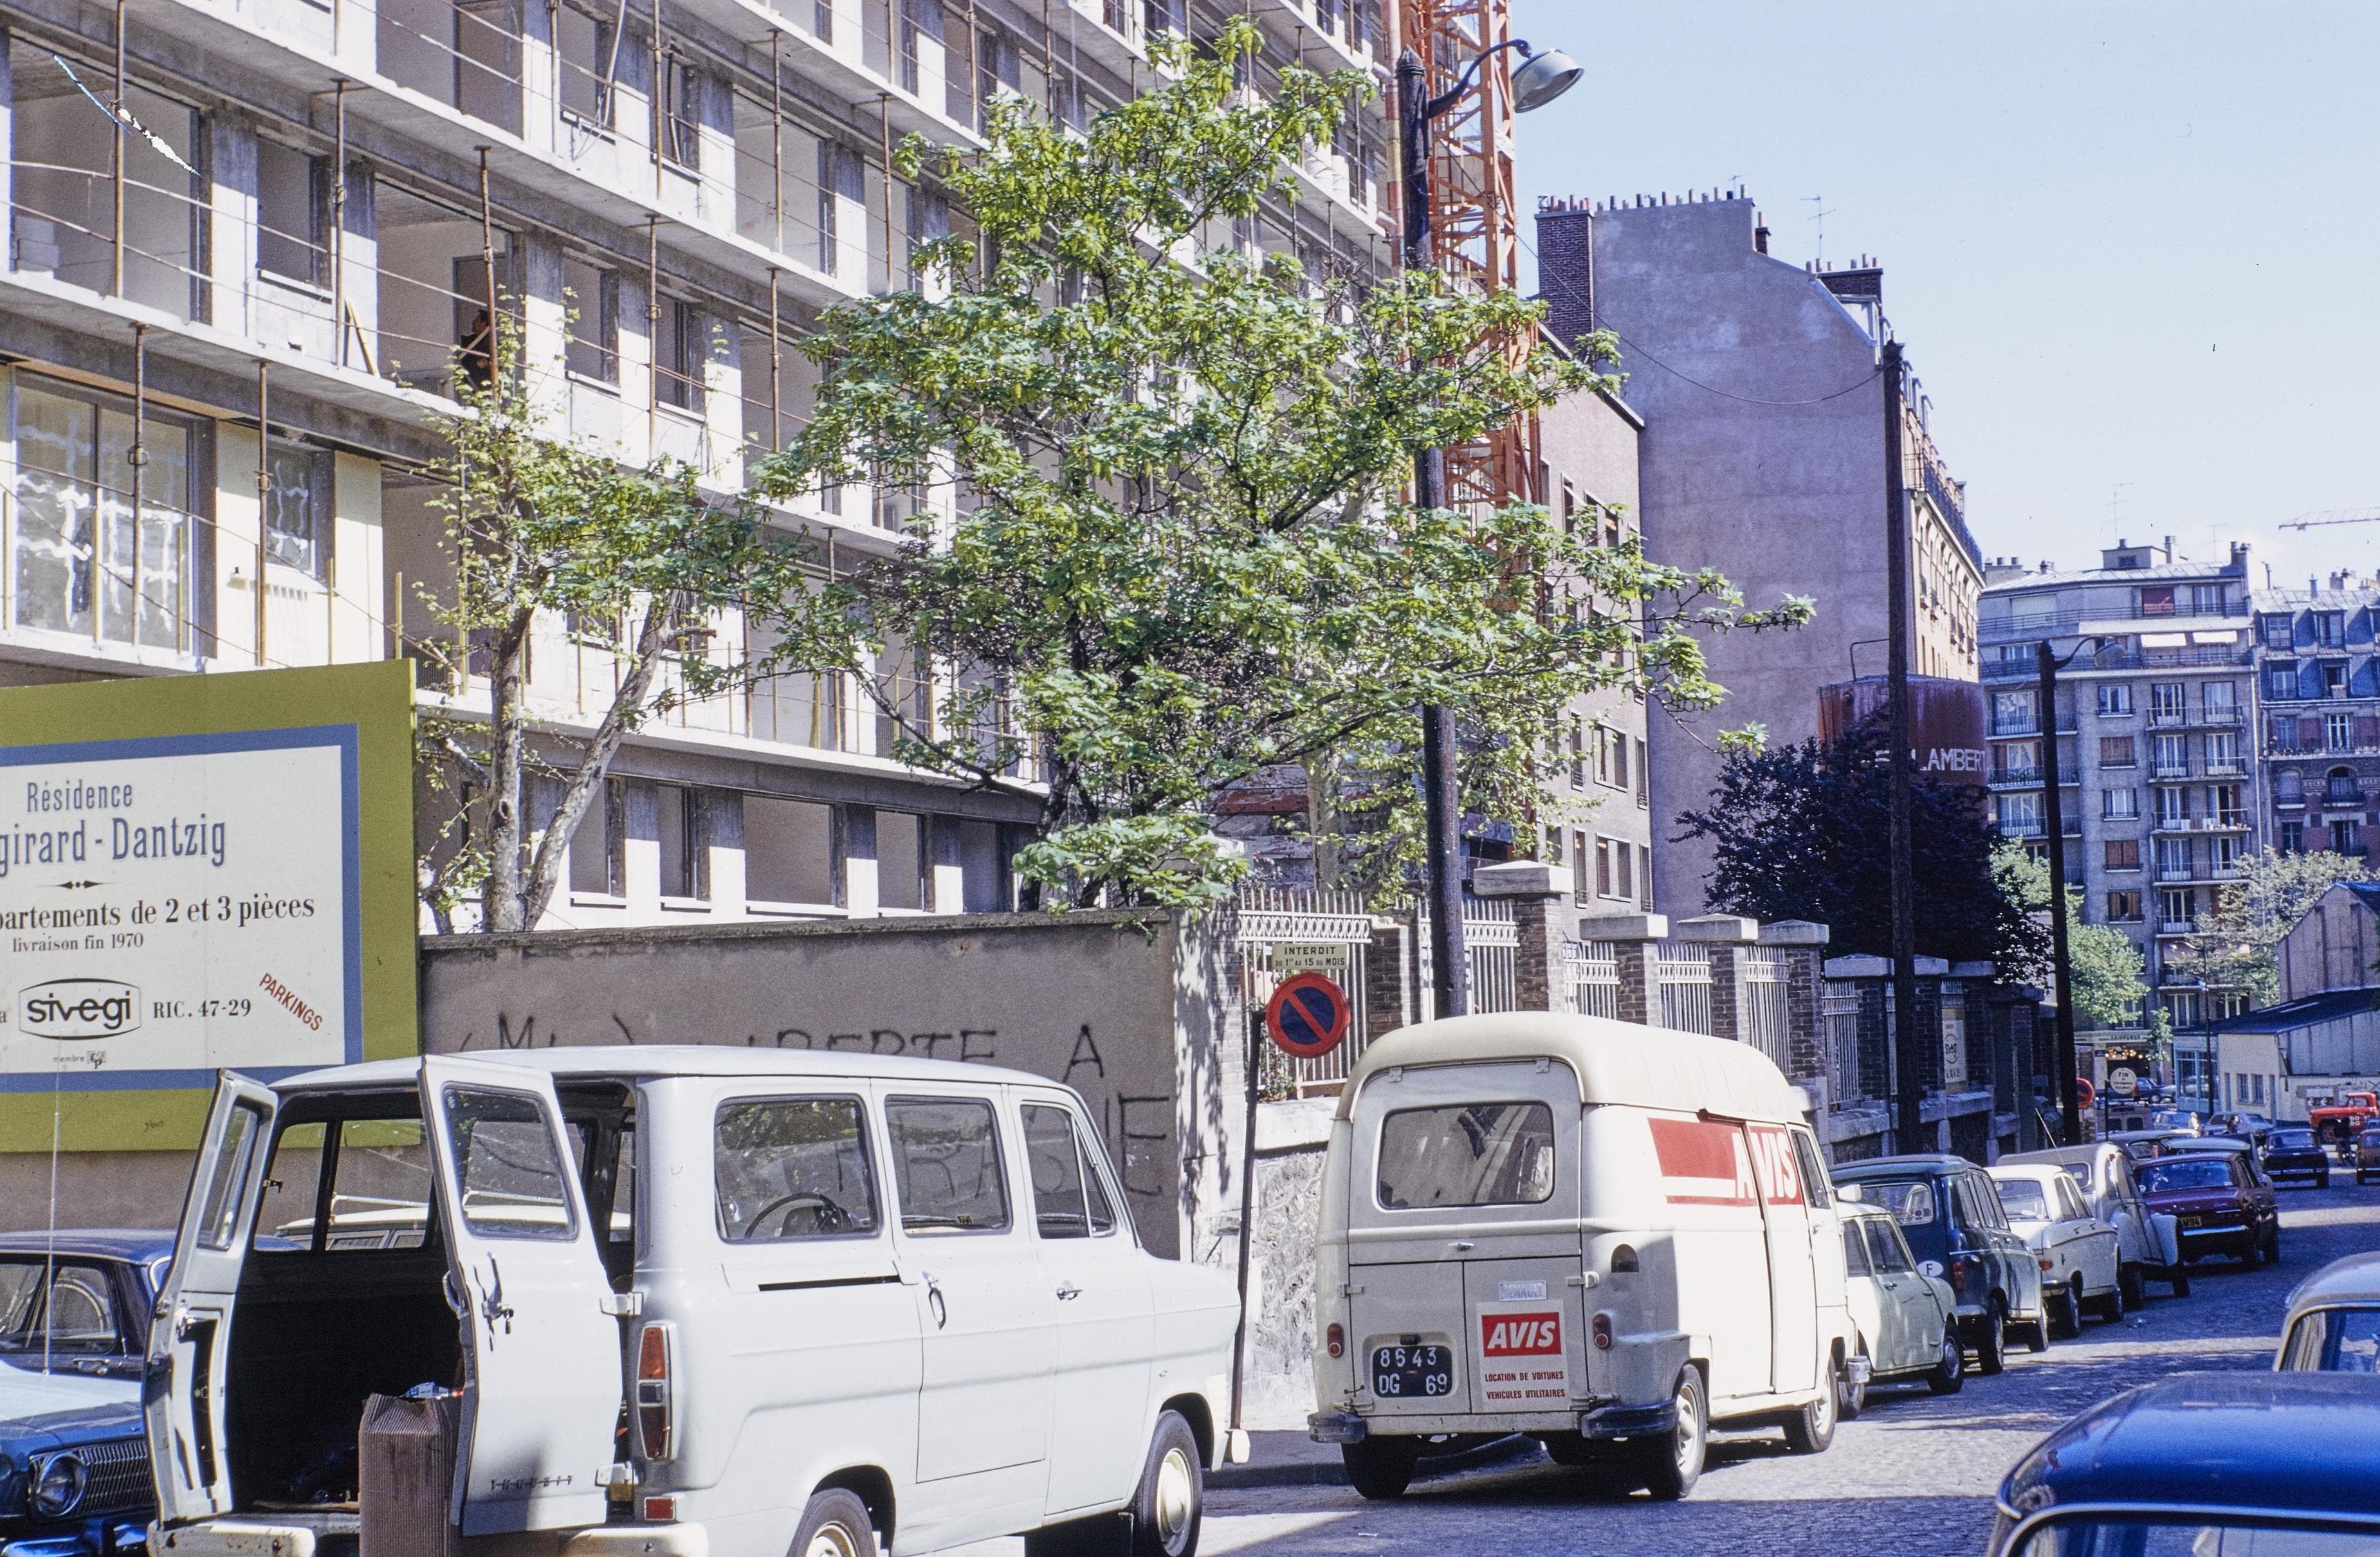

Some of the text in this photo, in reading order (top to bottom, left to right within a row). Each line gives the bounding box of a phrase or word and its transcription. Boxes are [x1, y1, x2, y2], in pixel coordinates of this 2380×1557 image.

[26, 779, 133, 812] Résidence
[112, 813, 225, 868] Dantzig
[0, 893, 315, 930] artements de 2 et 3 pièces
[13, 933, 144, 952] livraison fin 1970
[1285, 947, 1336, 955] INTERDIT
[1326, 958, 1345, 966] MOIS
[27, 991, 132, 1030] sivegi
[153, 1001, 192, 1019] RIC.
[198, 999, 252, 1019] 47-29
[259, 972, 323, 1031] PARKINGS
[1063, 1025, 1103, 1082] A
[1732, 1132, 1797, 1199] AVIS
[1926, 1263, 1933, 1275] F
[1487, 1321, 1556, 1349] AVIS
[1378, 1373, 1448, 1395] DG 69
[1485, 1371, 1564, 1382] LOCATION DE VOITURES
[1487, 1389, 1566, 1399] VEHICULES UTILITAIRES
